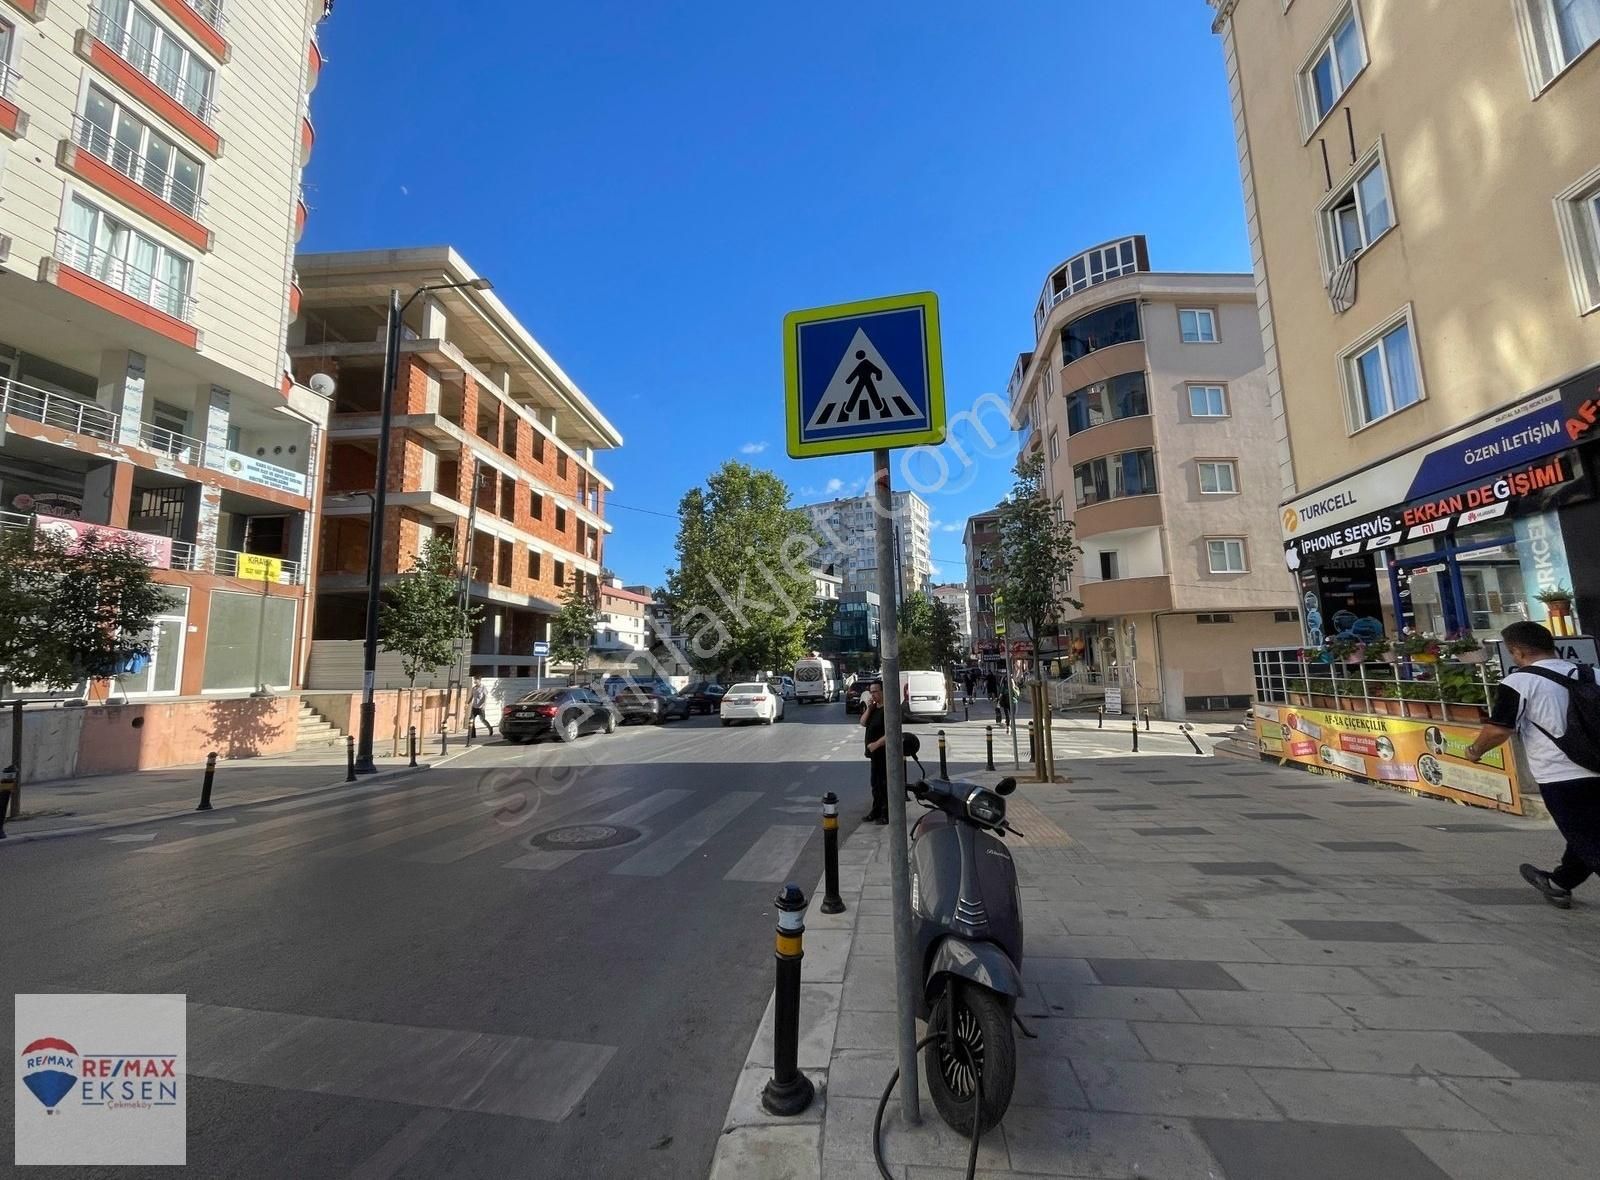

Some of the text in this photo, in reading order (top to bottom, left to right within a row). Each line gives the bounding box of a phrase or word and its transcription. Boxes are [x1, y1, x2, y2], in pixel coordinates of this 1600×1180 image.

[1464, 418, 1561, 466] ÖZEN İLETİŞİM
[1299, 490, 1357, 523] TURKCELL
[1300, 531, 1342, 555] İPHONE
[1344, 515, 1392, 543] SERVİS
[1403, 495, 1463, 526] EKRAN
[1467, 456, 1565, 508] DEĞİŞİMİ
[1324, 714, 1388, 732] AF-YA ÇİÇEKÇİLİK
